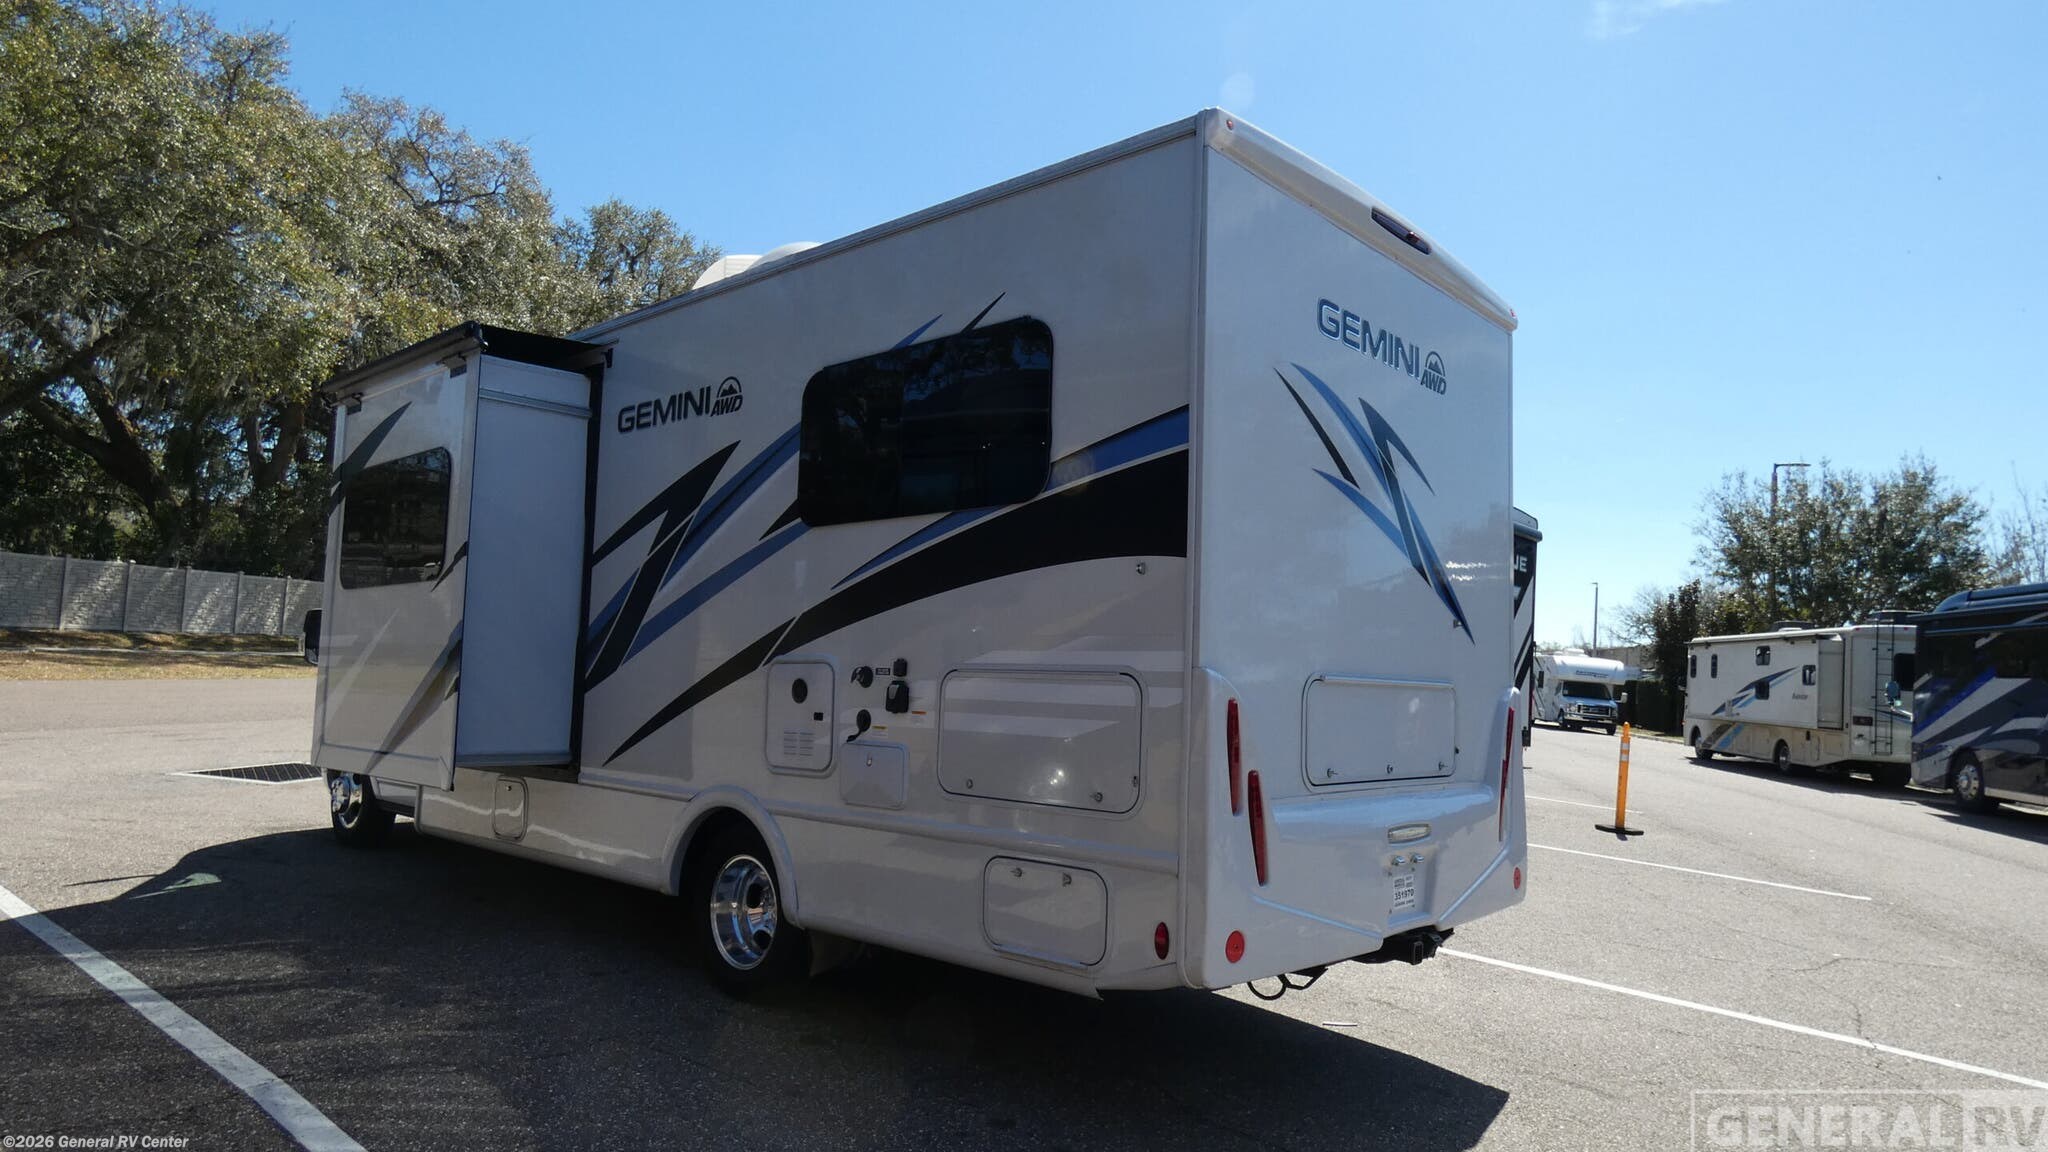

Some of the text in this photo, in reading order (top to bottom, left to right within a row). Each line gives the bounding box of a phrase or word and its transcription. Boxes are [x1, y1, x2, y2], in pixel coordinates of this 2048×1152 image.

[1317, 298, 1447, 396] GEMINI AWD
[618, 386, 743, 433] GEMINI AWD
